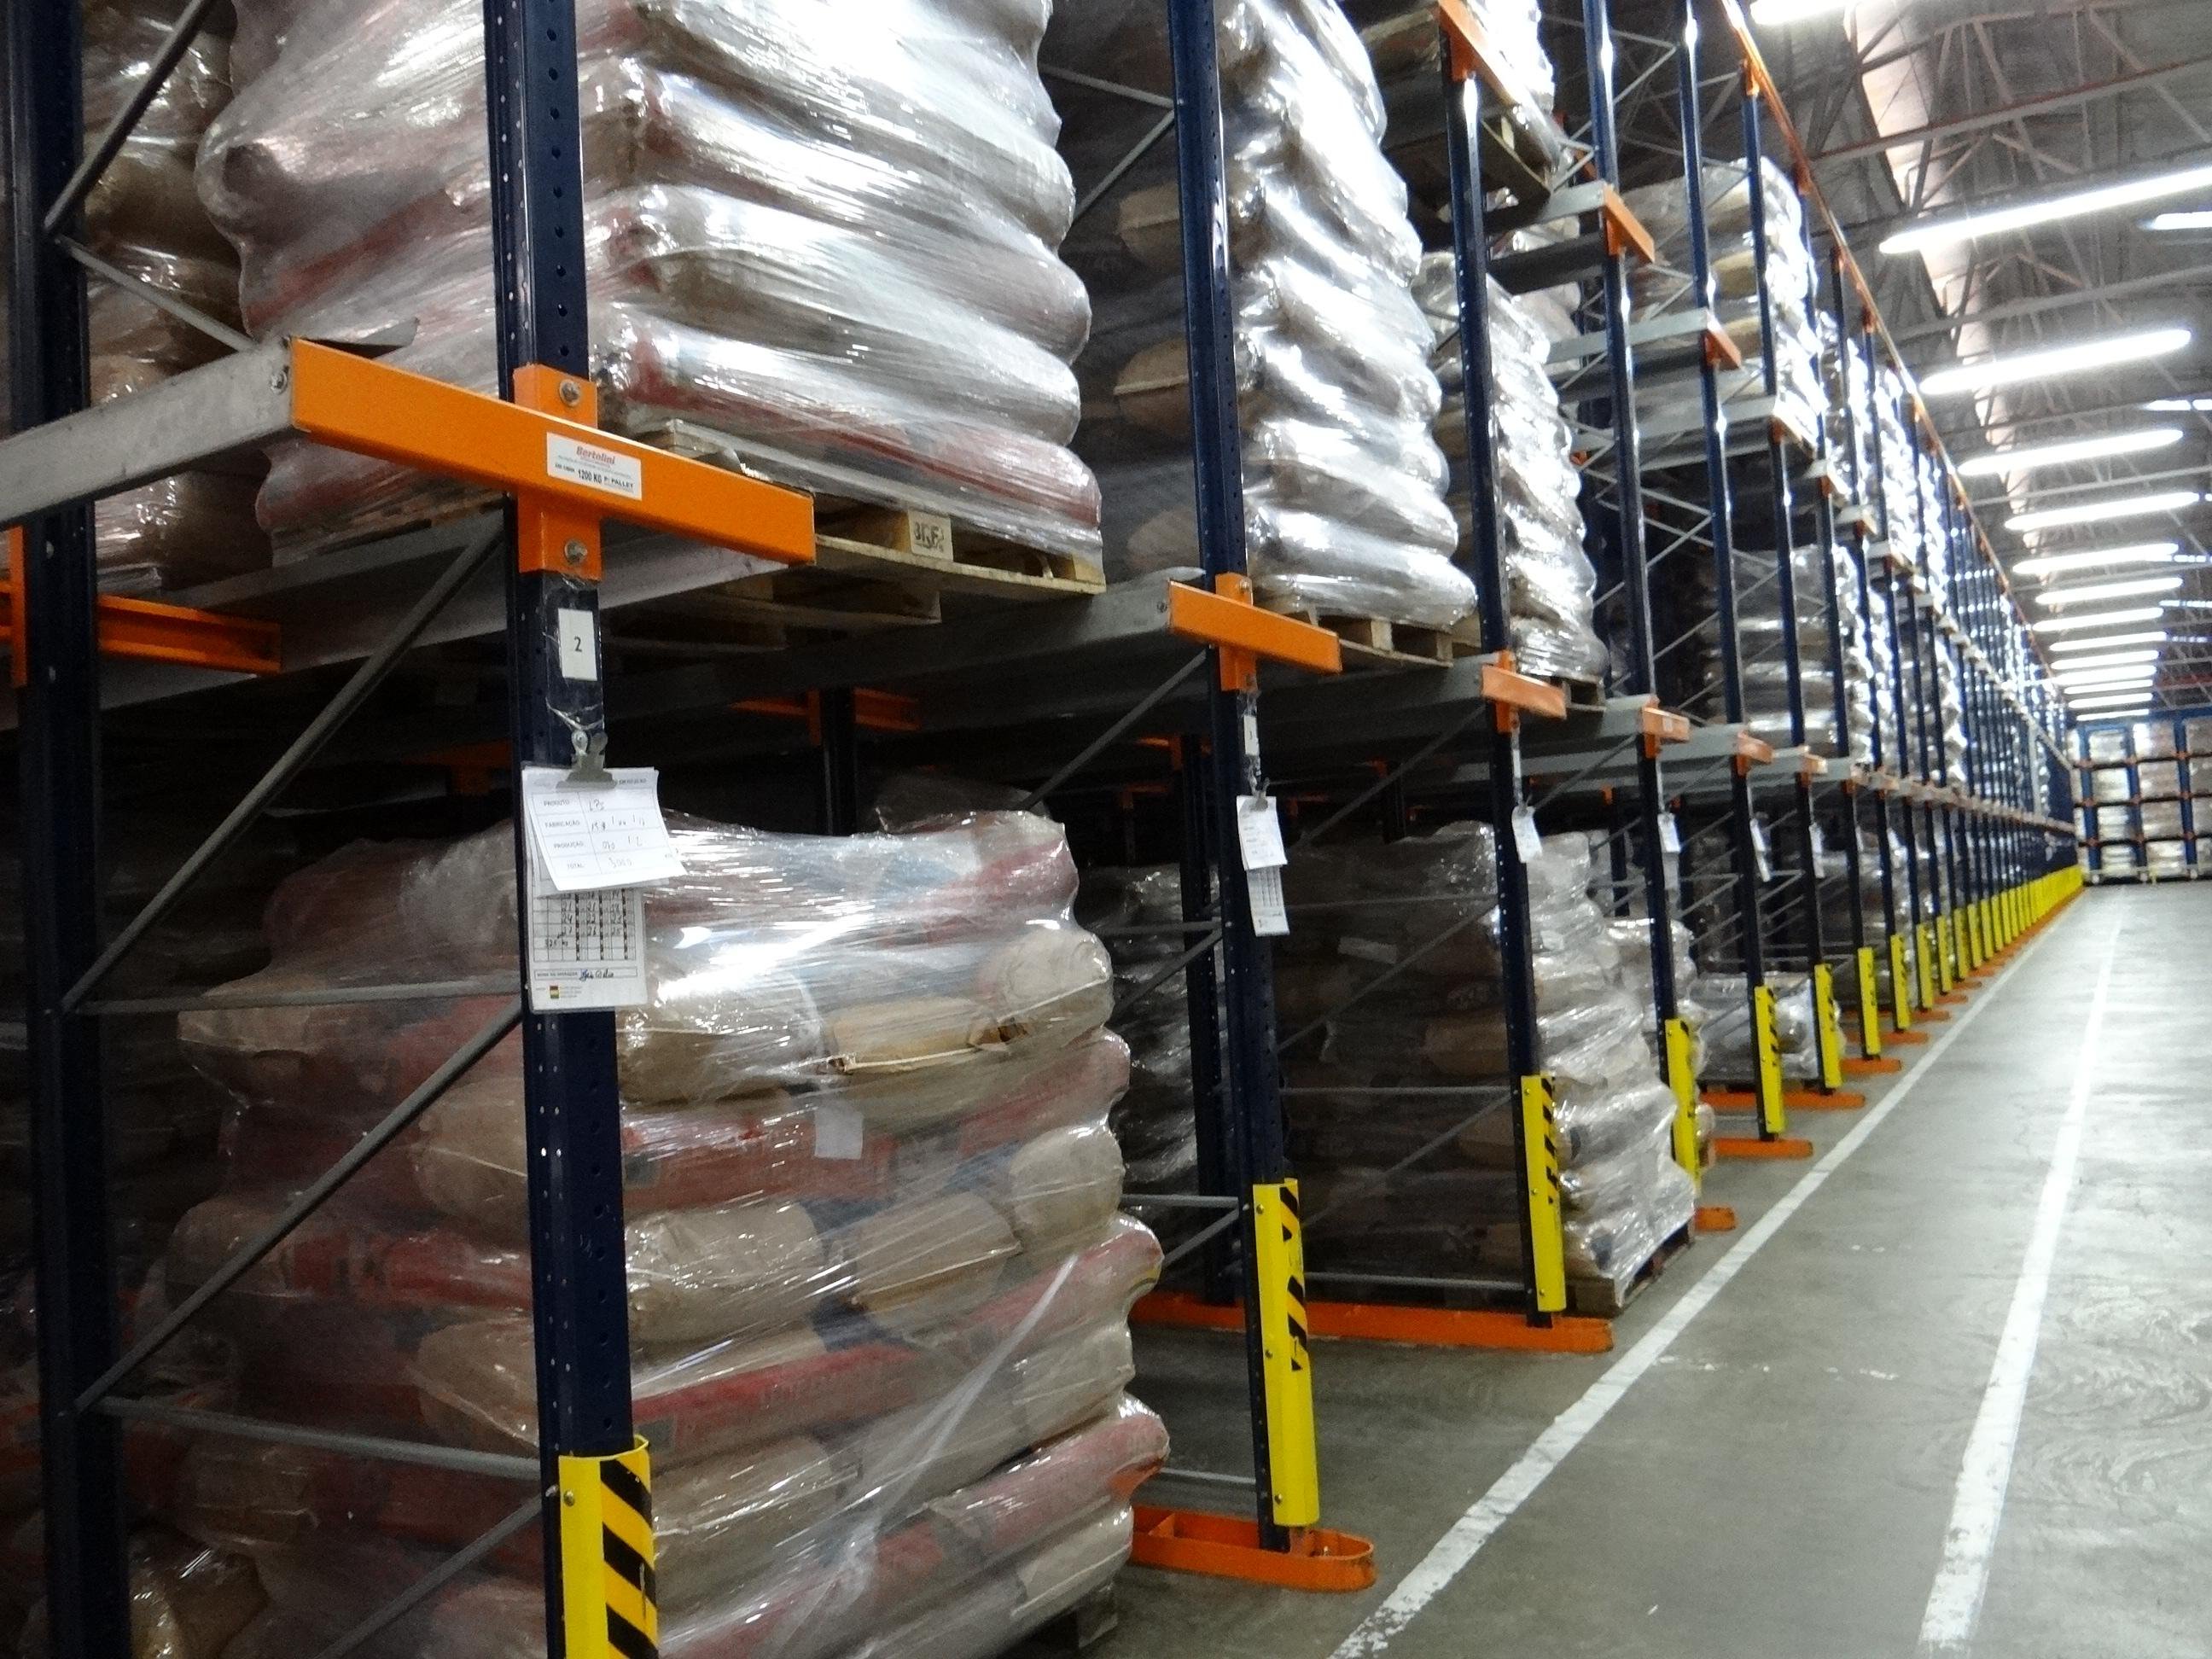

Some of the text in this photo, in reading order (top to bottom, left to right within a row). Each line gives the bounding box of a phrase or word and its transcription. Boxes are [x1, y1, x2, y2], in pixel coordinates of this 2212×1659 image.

[576, 445, 615, 465] Bertolini
[578, 469, 592, 480] 1200
[593, 473, 602, 484] KG
[611, 478, 633, 489] PALLET
[573, 636, 583, 653] 2
